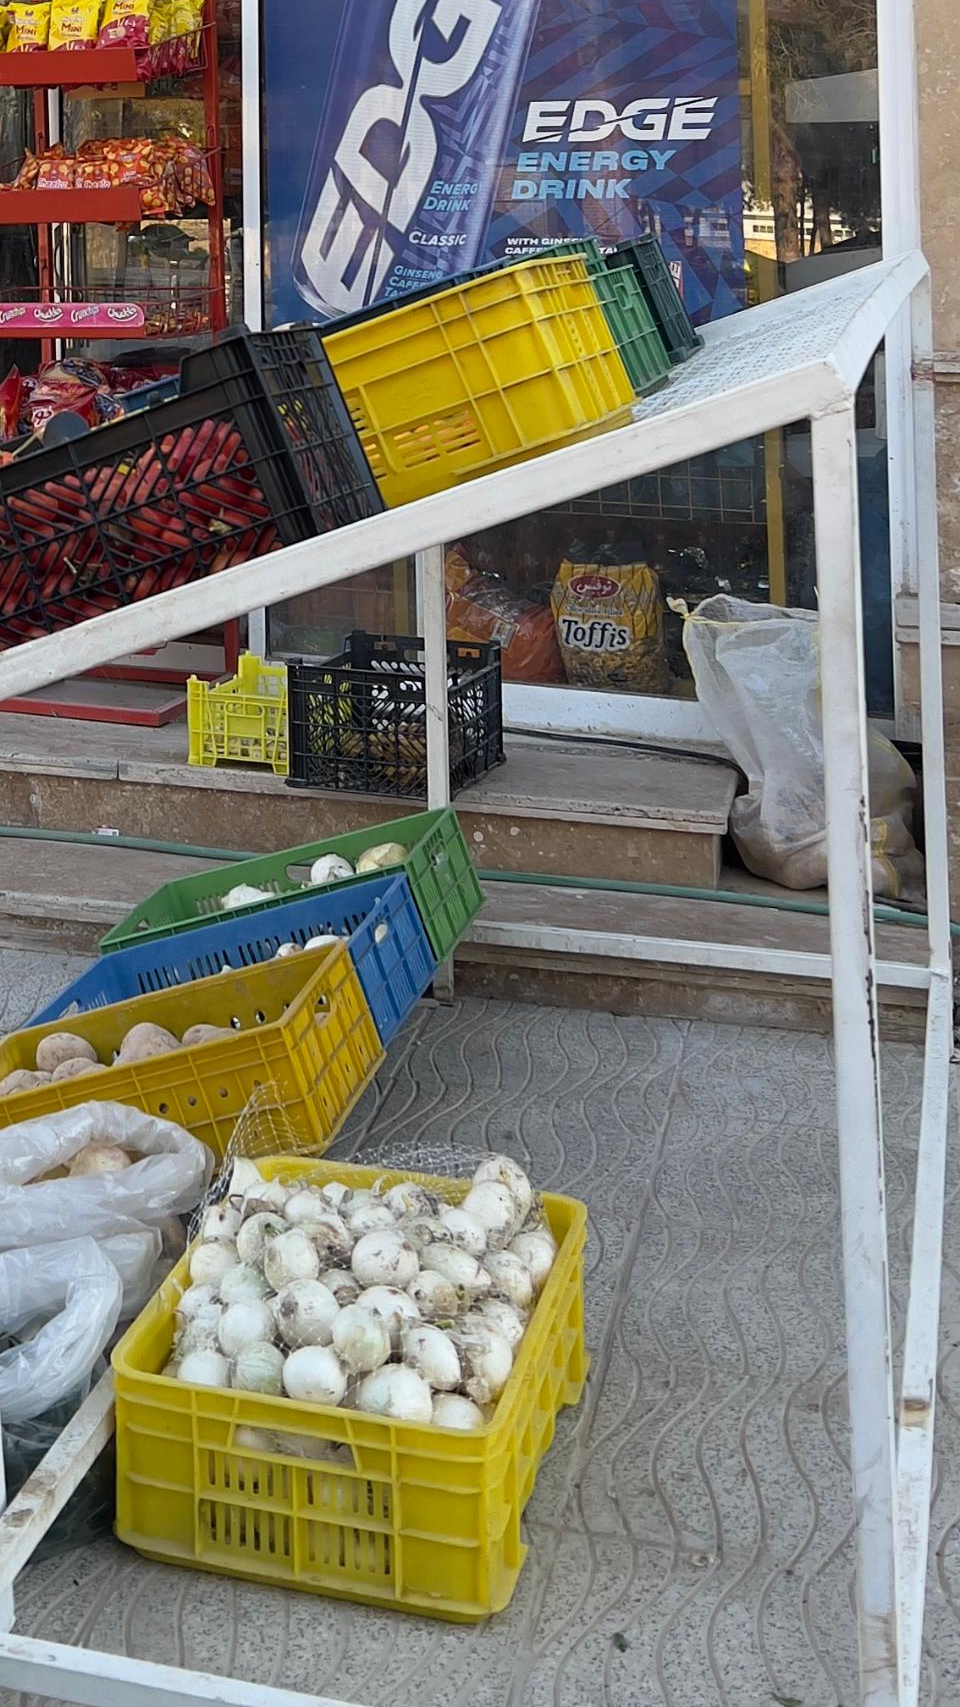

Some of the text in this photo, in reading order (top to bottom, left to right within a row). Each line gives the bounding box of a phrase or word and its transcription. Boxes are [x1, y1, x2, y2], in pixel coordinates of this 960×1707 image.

[522, 96, 719, 143] EDGE
[516, 150, 676, 174] ENERGY
[511, 178, 631, 201] DRINK
[423, 196, 472, 212] DRINK
[408, 230, 468, 247] CLASSIC
[507, 237, 539, 246] WITH
[562, 619, 628, 648] Toffis
